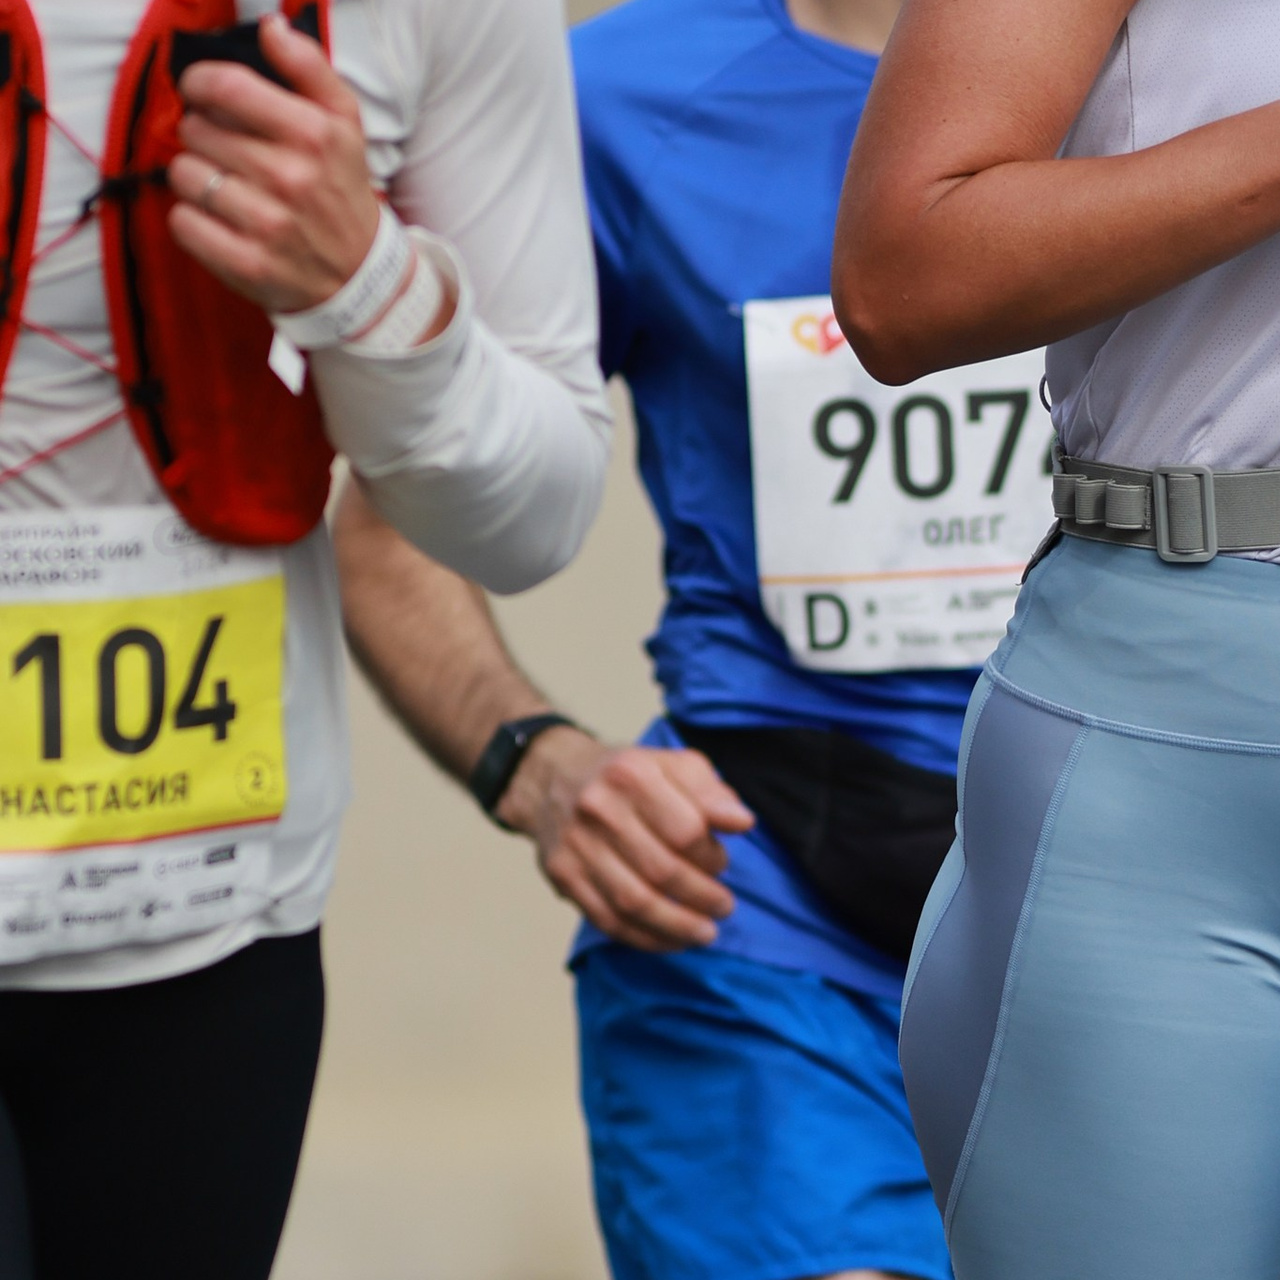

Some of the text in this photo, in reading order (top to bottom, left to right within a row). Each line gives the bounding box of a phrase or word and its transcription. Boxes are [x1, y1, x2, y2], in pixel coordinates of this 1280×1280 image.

[812, 388, 1055, 506] 907
[922, 517, 1005, 547] ОЛЕГ
[806, 592, 850, 651] D
[11, 615, 237, 761] 104
[0, 772, 191, 819] НАСТАСИЯ
